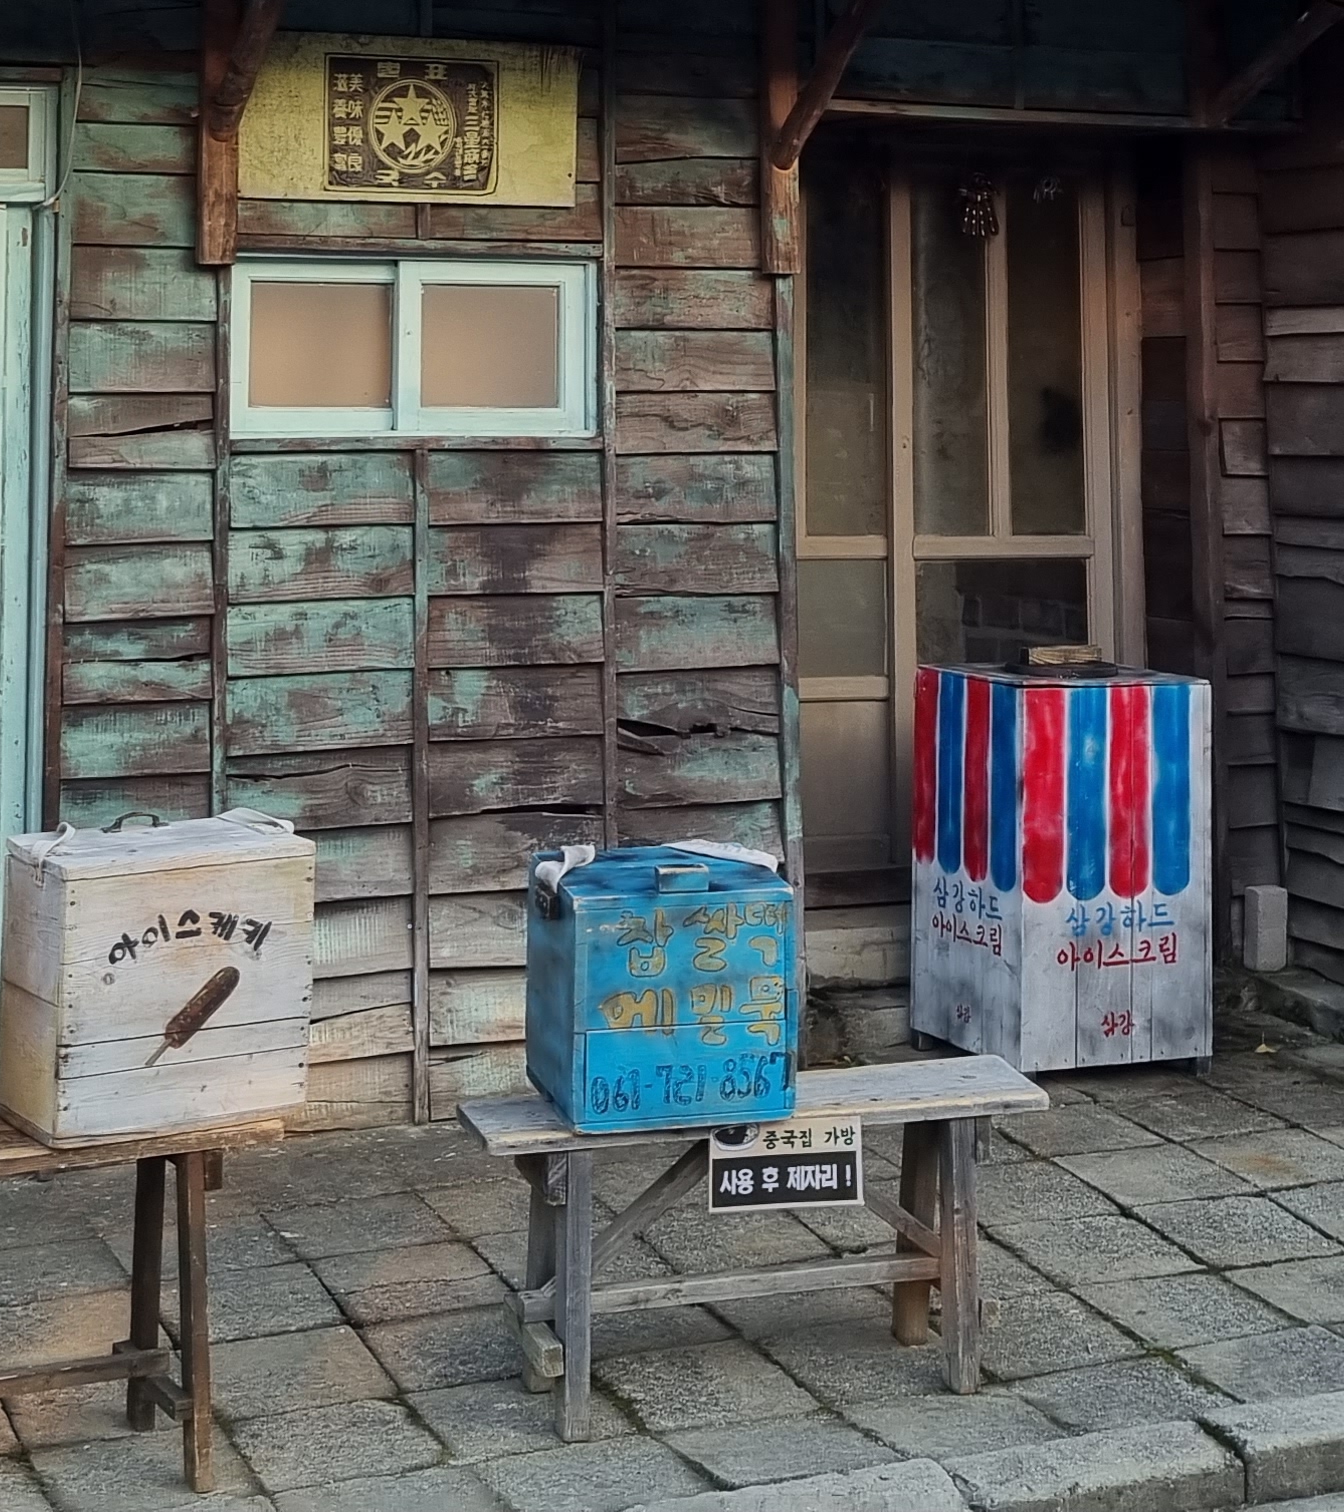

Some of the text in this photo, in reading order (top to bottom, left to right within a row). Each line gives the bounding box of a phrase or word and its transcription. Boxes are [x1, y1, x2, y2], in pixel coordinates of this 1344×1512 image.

[933, 876, 1002, 920] 삼강하드
[932, 910, 1002, 956] 아이스크림
[1065, 899, 1174, 937] 삼강하드
[617, 900, 789, 977] 찹쌀떡
[1057, 932, 1178, 971] 아이스크림
[598, 975, 786, 1046] 메밀묵
[1100, 1010, 1135, 1037] 삼강
[763, 1125, 856, 1150] 중국집 가방
[719, 1168, 754, 1195] 사용
[761, 1166, 779, 1192] 후
[786, 1164, 838, 1191] 제자리
